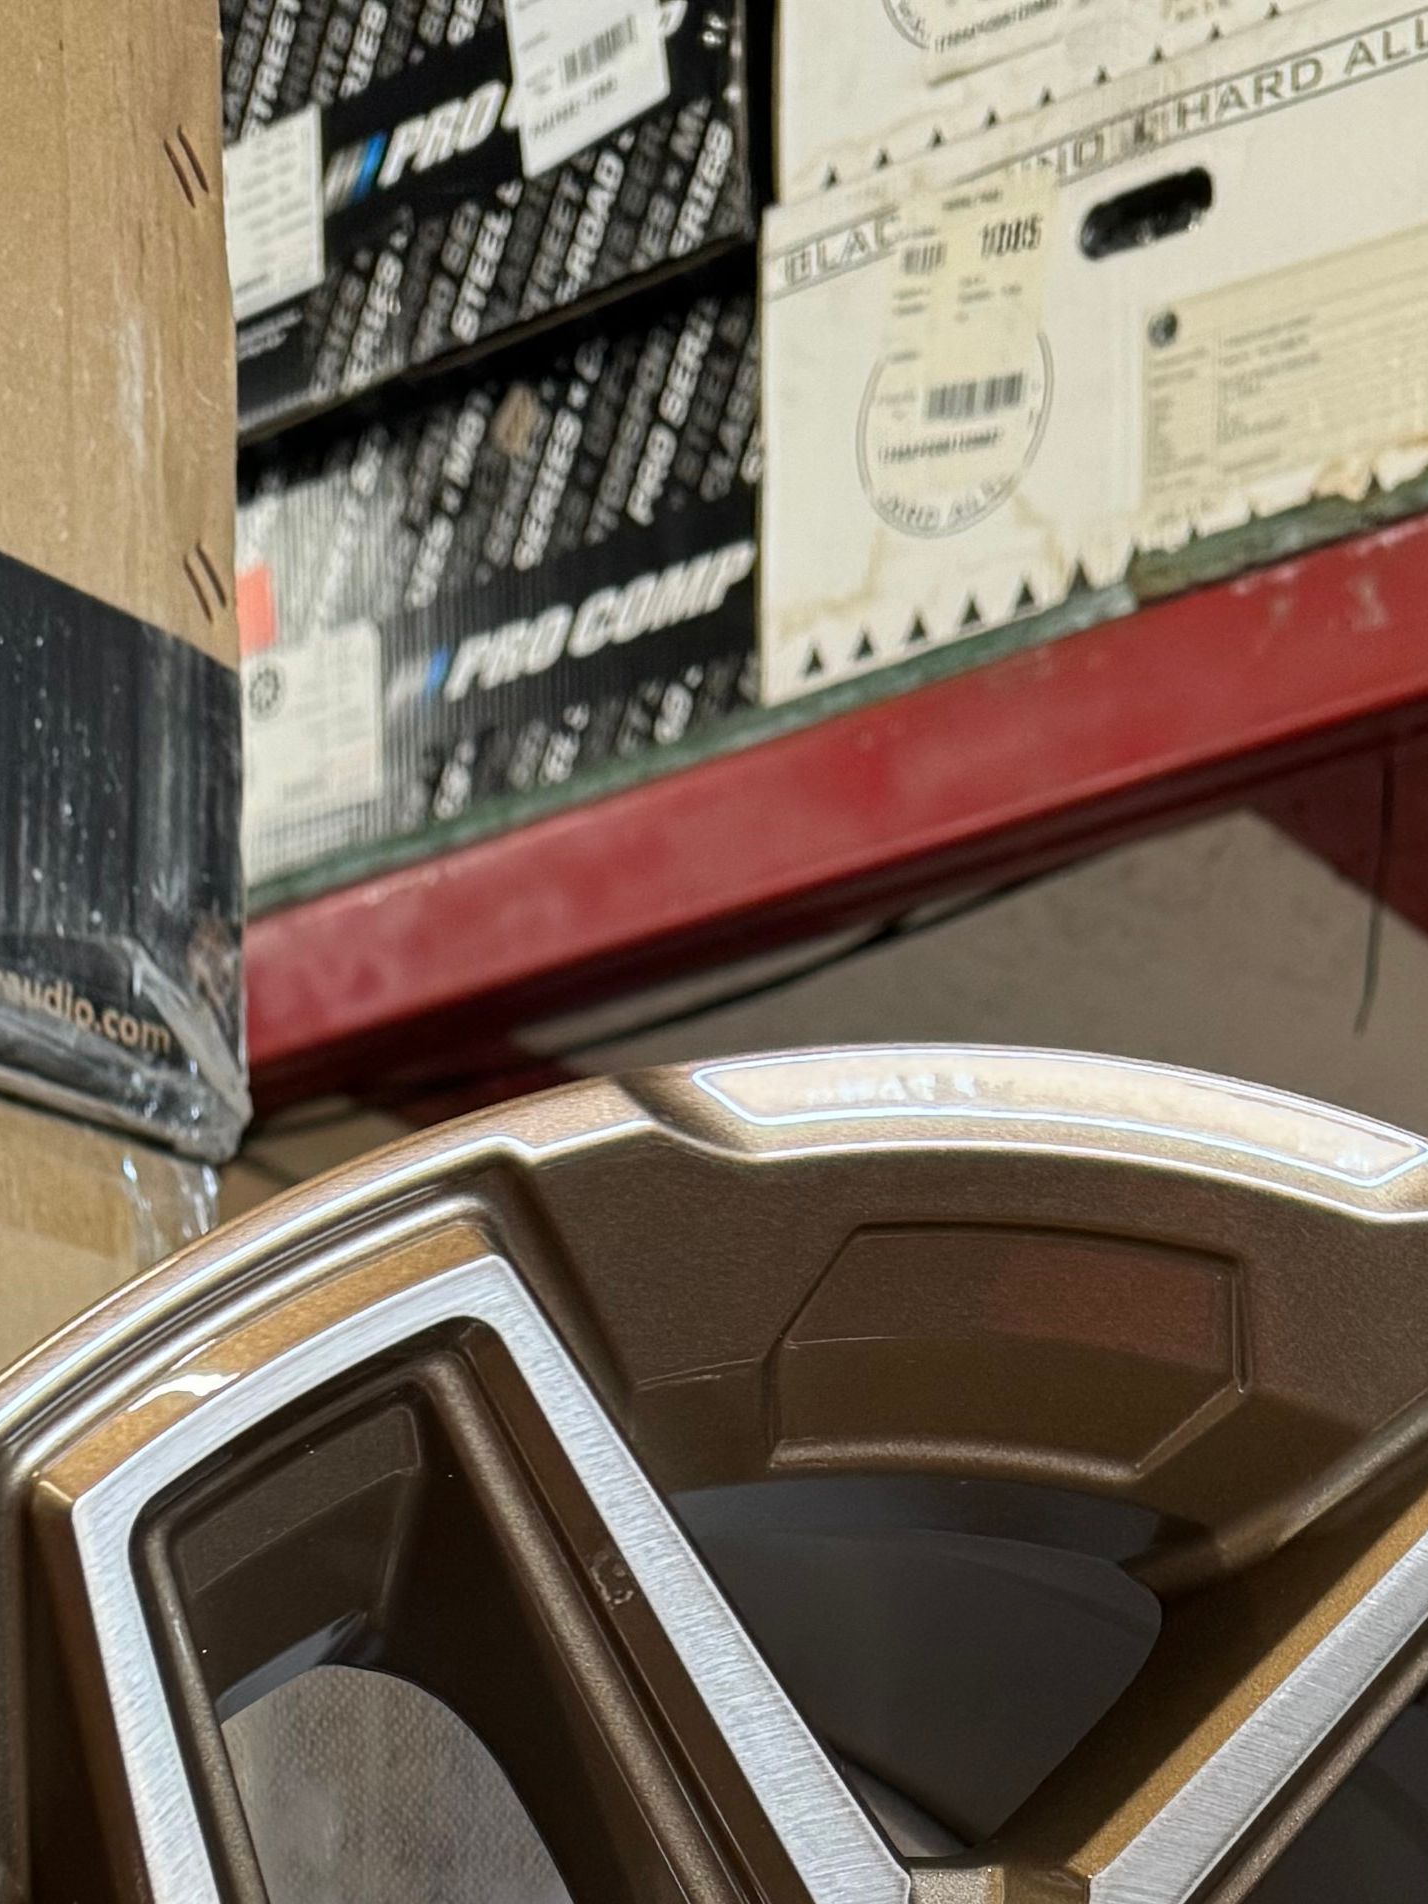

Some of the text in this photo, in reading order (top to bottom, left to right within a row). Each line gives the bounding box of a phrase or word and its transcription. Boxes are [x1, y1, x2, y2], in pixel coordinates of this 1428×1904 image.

[377, 79, 507, 190] PRO
[1177, 57, 1325, 131] HARD
[450, 208, 513, 345] STEEL
[784, 212, 902, 287] BLAC
[512, 406, 583, 572] SERIES
[626, 421, 679, 528] PRO
[444, 540, 757, 702] PRO COMP
